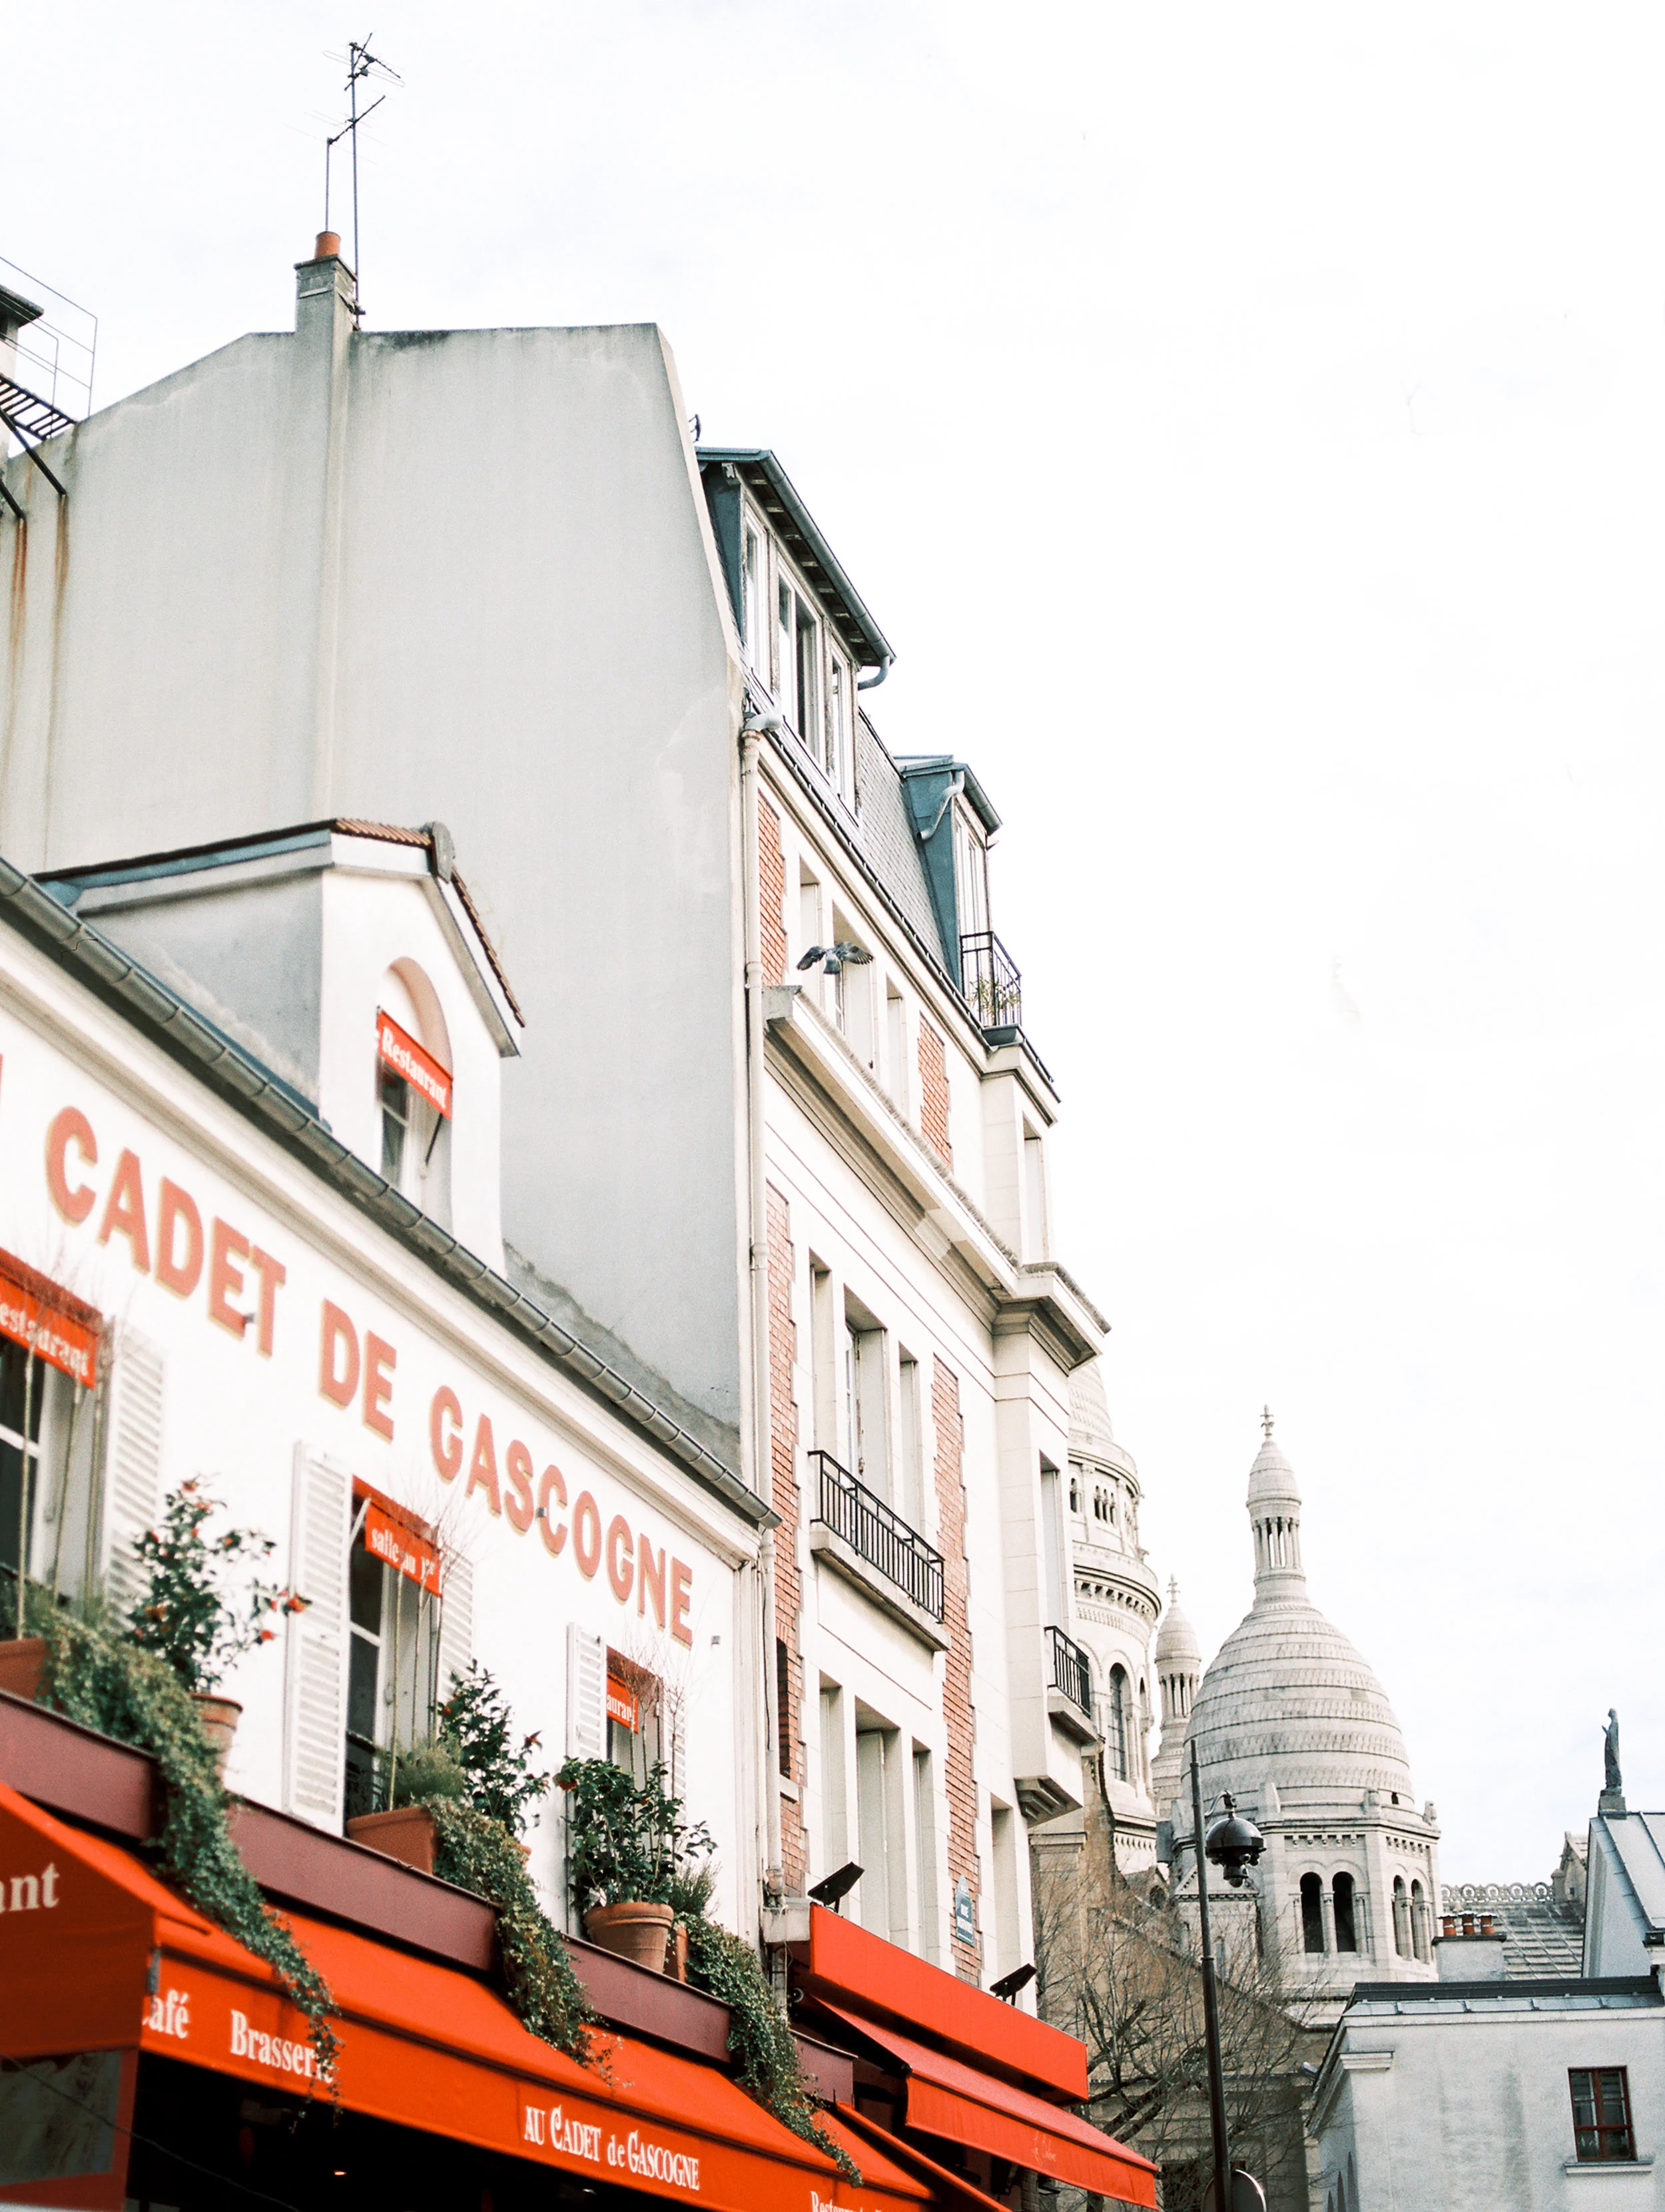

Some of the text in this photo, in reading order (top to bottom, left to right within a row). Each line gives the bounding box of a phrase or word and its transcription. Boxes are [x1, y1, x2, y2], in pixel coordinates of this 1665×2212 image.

[382, 1026, 447, 1109] Restaurant
[45, 1105, 693, 1651] CADET DE GASCOGNE
[142, 1989, 190, 2039] afé
[524, 2104, 700, 2191] AU CADET de GASCOGNE
